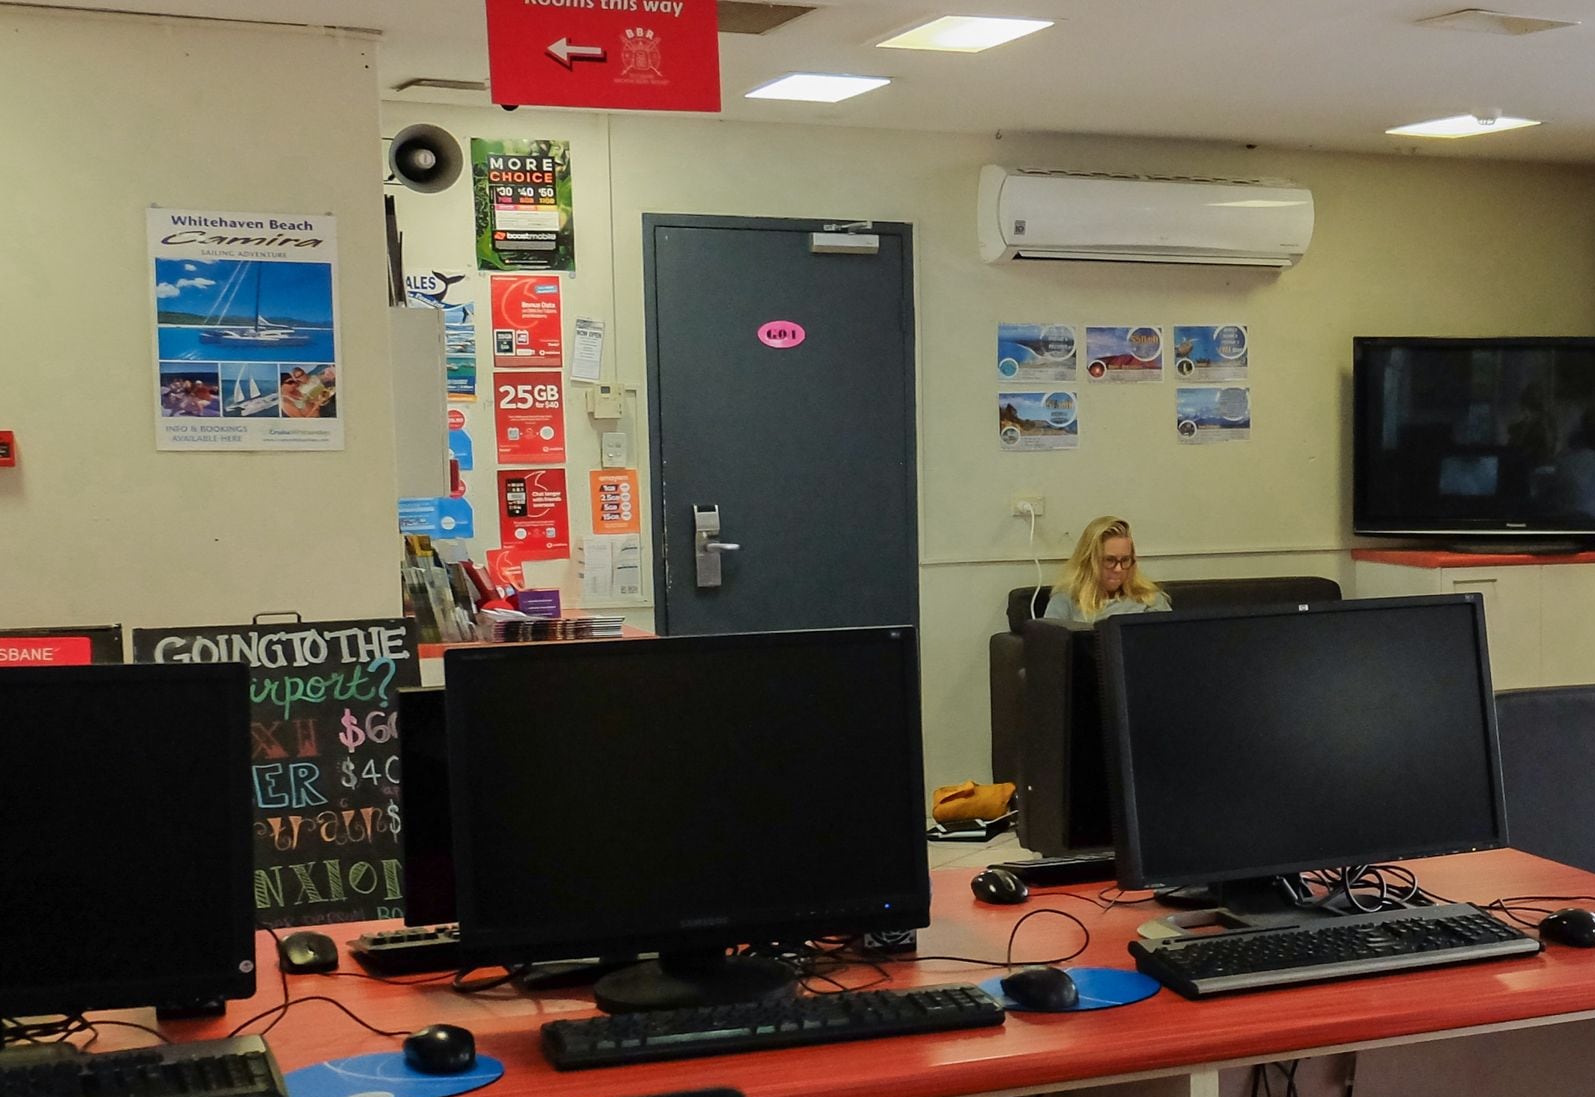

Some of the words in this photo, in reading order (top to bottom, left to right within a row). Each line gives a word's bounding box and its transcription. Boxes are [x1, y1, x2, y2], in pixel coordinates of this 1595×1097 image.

[601, 0, 637, 11] this
[644, 1, 683, 17] way
[625, 27, 654, 41] BBR
[490, 158, 553, 171] MORE
[490, 172, 553, 183] CHOICE
[171, 215, 263, 229] Whitehaven
[269, 219, 313, 231] Beach
[161, 231, 323, 248] Camira
[238, 250, 287, 258] ADVENTURE
[405, 276, 436, 290] ALES
[154, 632, 286, 668] GOING
[281, 629, 329, 666] TO
[326, 626, 410, 664] THE
